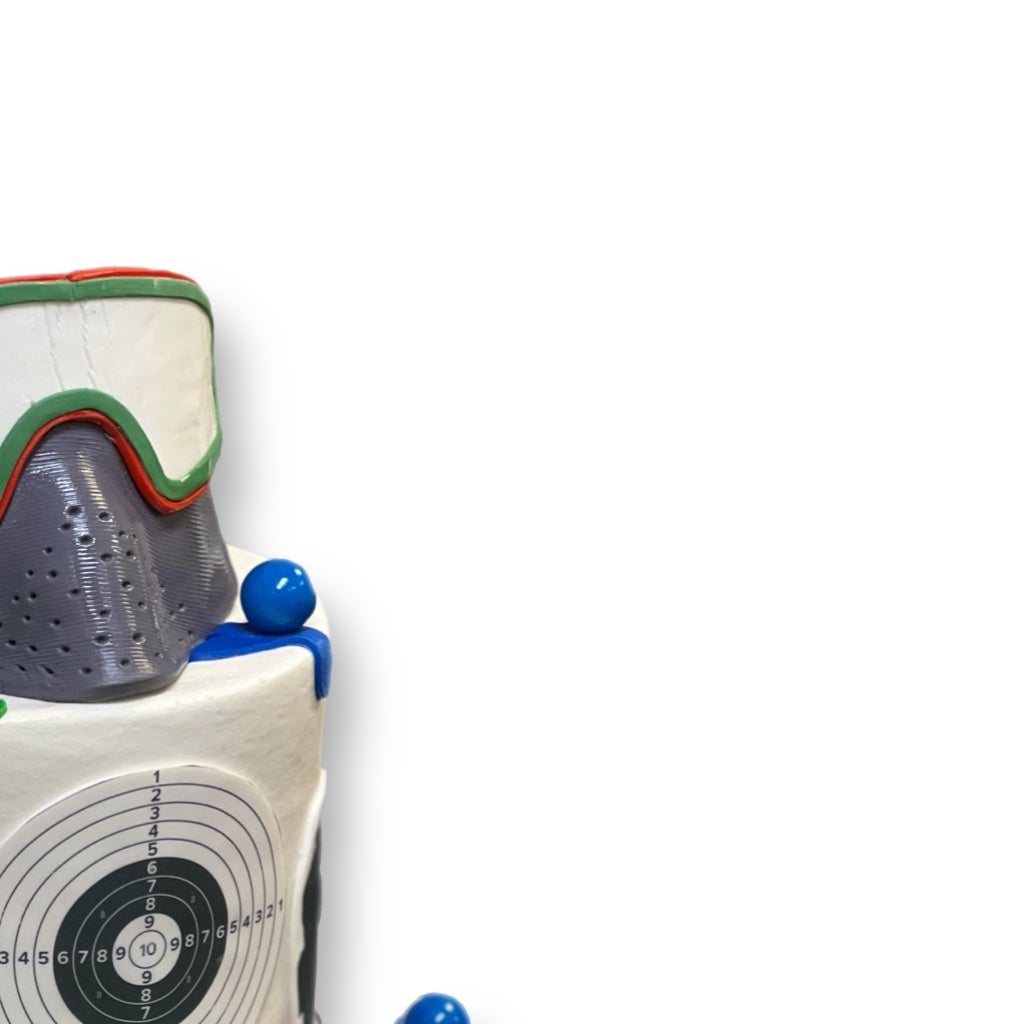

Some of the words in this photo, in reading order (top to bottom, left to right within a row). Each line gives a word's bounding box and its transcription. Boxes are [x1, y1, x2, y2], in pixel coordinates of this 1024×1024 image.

[153, 770, 160, 783] 1
[151, 788, 161, 801] 2
[149, 807, 159, 820] 3
[148, 825, 159, 838] 4
[148, 843, 158, 856] 5
[147, 861, 157, 874] 6
[147, 879, 157, 892] 7
[145, 898, 155, 911] 8
[144, 916, 154, 929] 9
[0, 951, 9, 964] 3
[18, 952, 29, 964] 4
[39, 952, 49, 964] 5
[58, 951, 68, 964] 6
[79, 951, 88, 963] 7
[97, 949, 107, 962] 8
[116, 947, 126, 960] 9
[140, 942, 156, 956] 10
[170, 938, 179, 951] 9
[185, 934, 194, 947] 8
[202, 930, 210, 943] 7
[217, 925, 224, 938] 6
[230, 920, 237, 933] 5
[241, 914, 249, 927] 4
[255, 911, 262, 924] 3
[267, 905, 274, 918] 2
[142, 971, 152, 984] 9
[141, 989, 151, 1002] 8
[141, 1007, 151, 1020] 7
